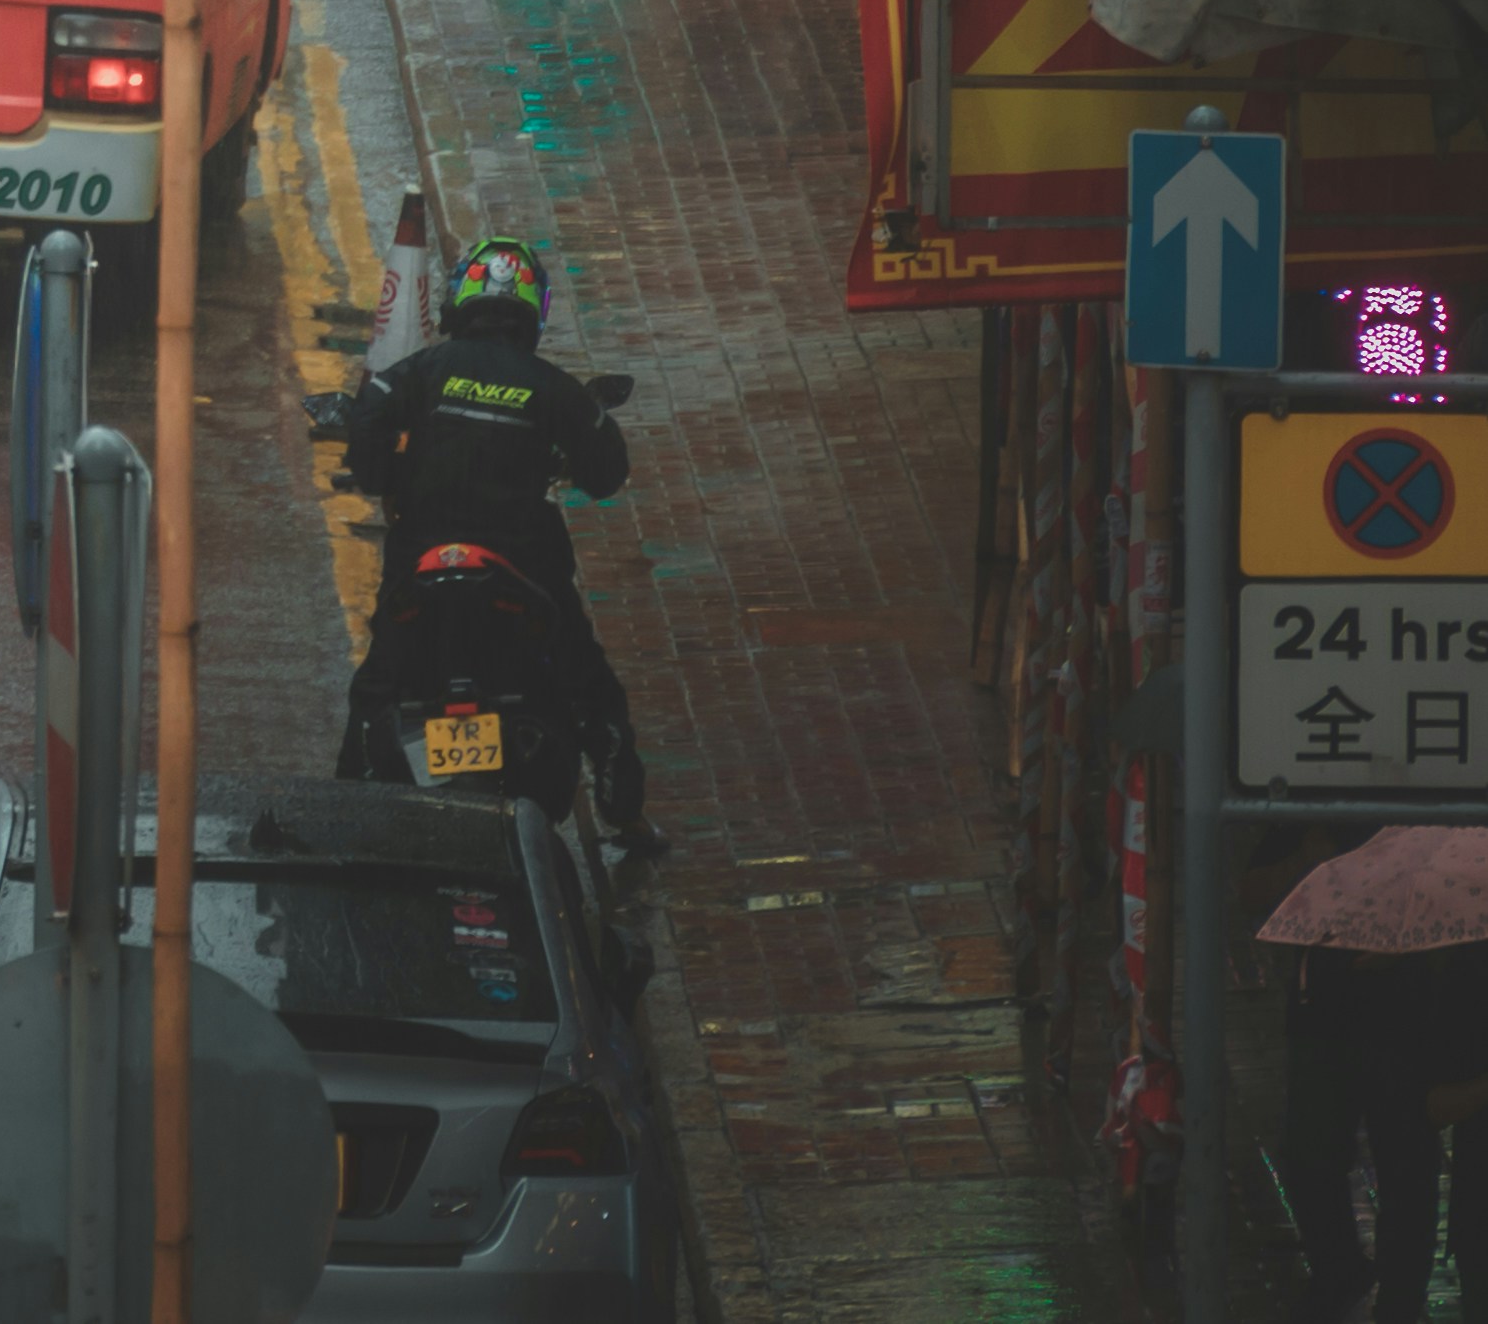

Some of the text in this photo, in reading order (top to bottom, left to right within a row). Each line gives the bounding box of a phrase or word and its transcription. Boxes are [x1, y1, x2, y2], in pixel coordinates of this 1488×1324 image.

[1273, 607, 1488, 662] 24 hrs
[447, 723, 481, 742] YR
[1294, 685, 1470, 765] 全日
[430, 745, 501, 770] 3927
